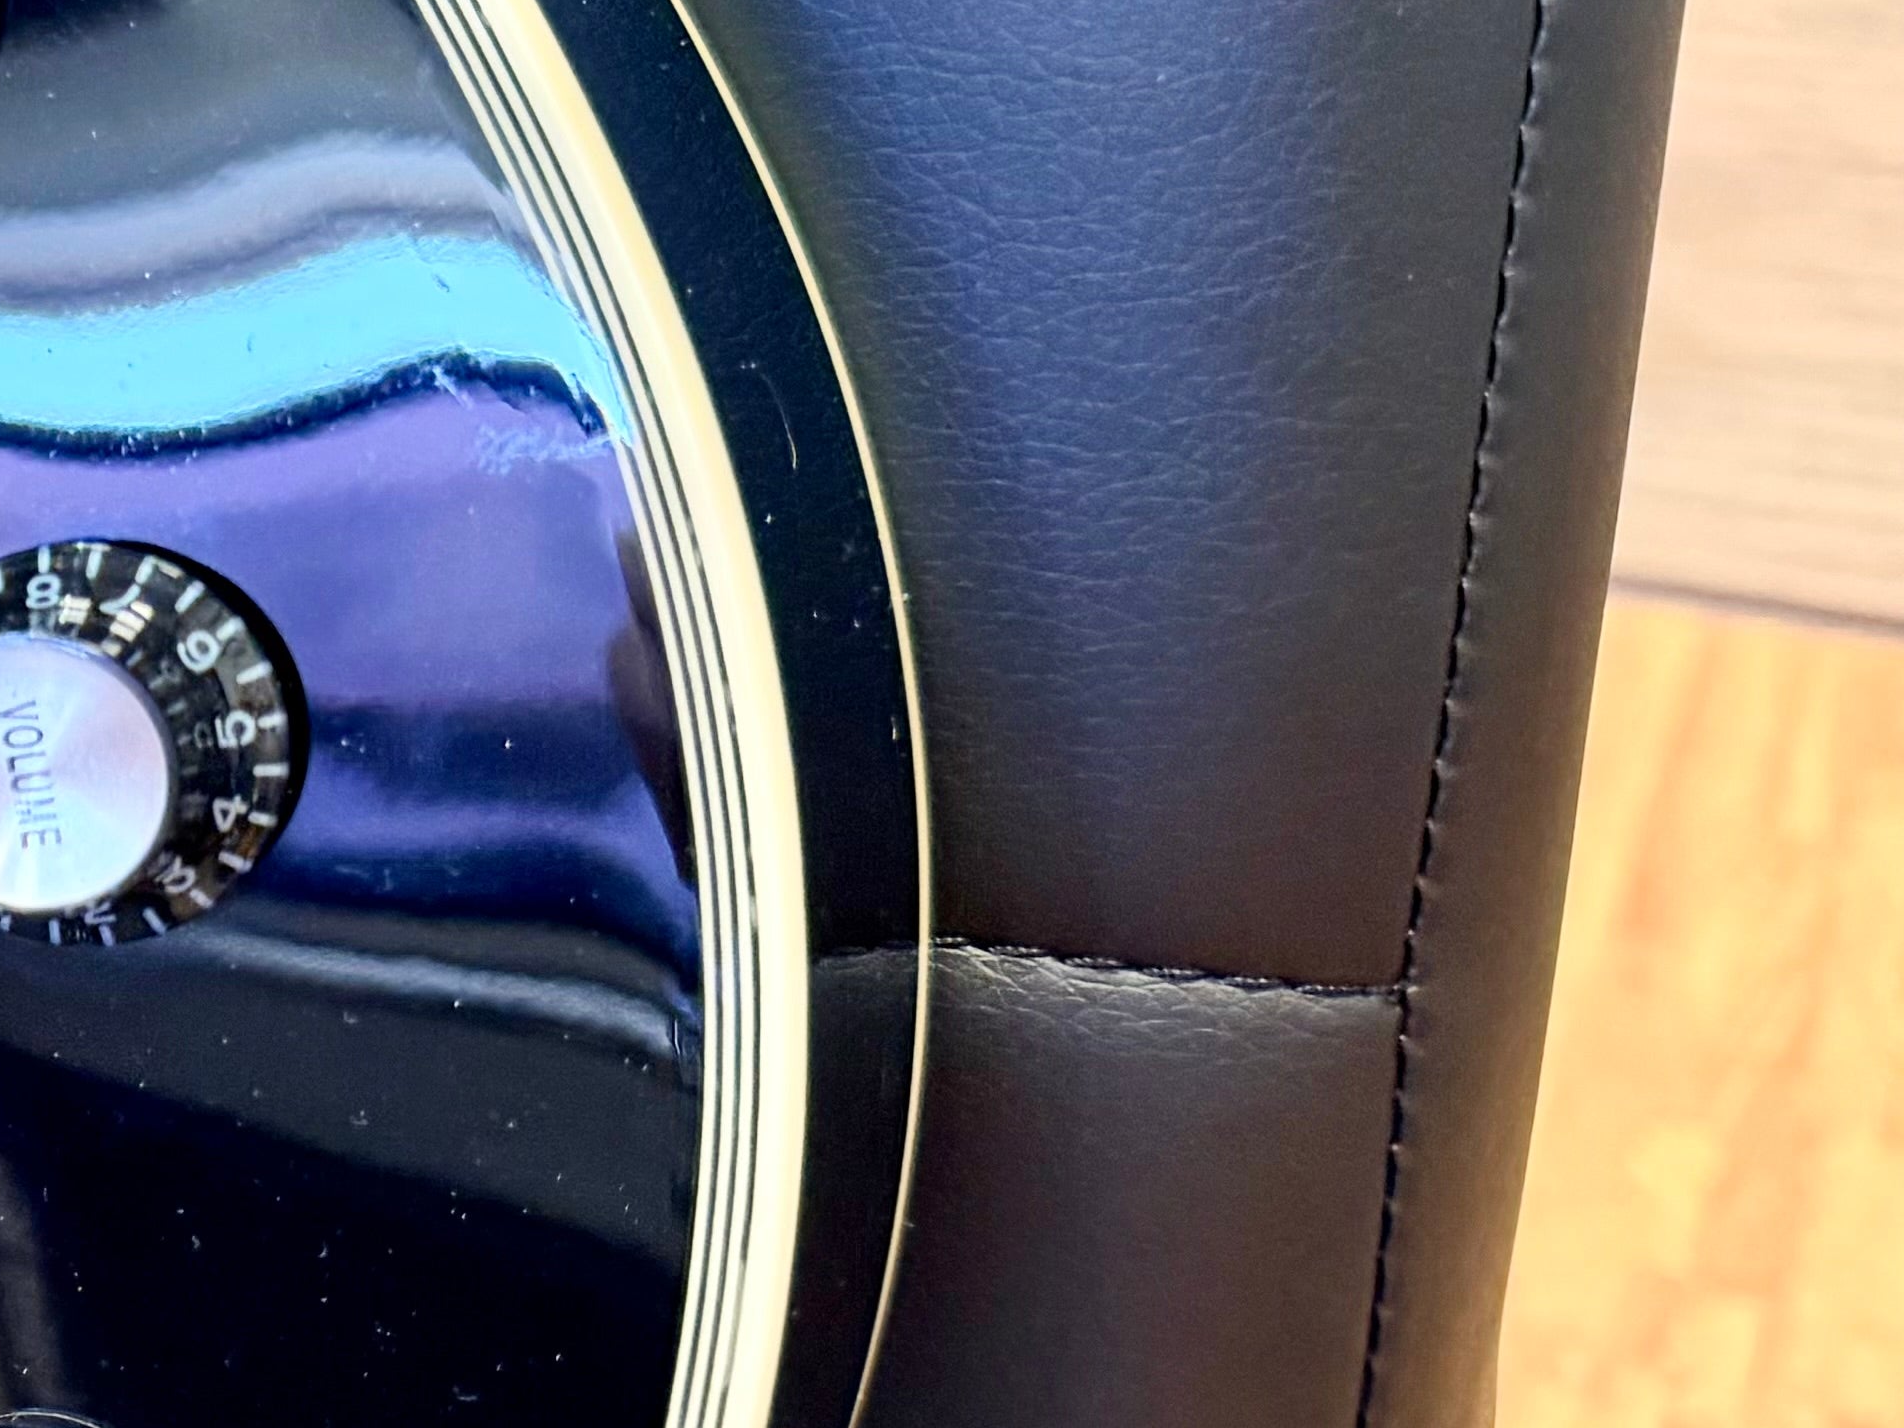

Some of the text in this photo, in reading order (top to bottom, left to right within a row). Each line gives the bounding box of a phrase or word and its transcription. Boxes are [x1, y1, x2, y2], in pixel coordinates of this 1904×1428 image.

[26, 573, 62, 609] 8
[176, 629, 221, 672] 6
[215, 710, 257, 748] 5
[212, 794, 248, 832] 4
